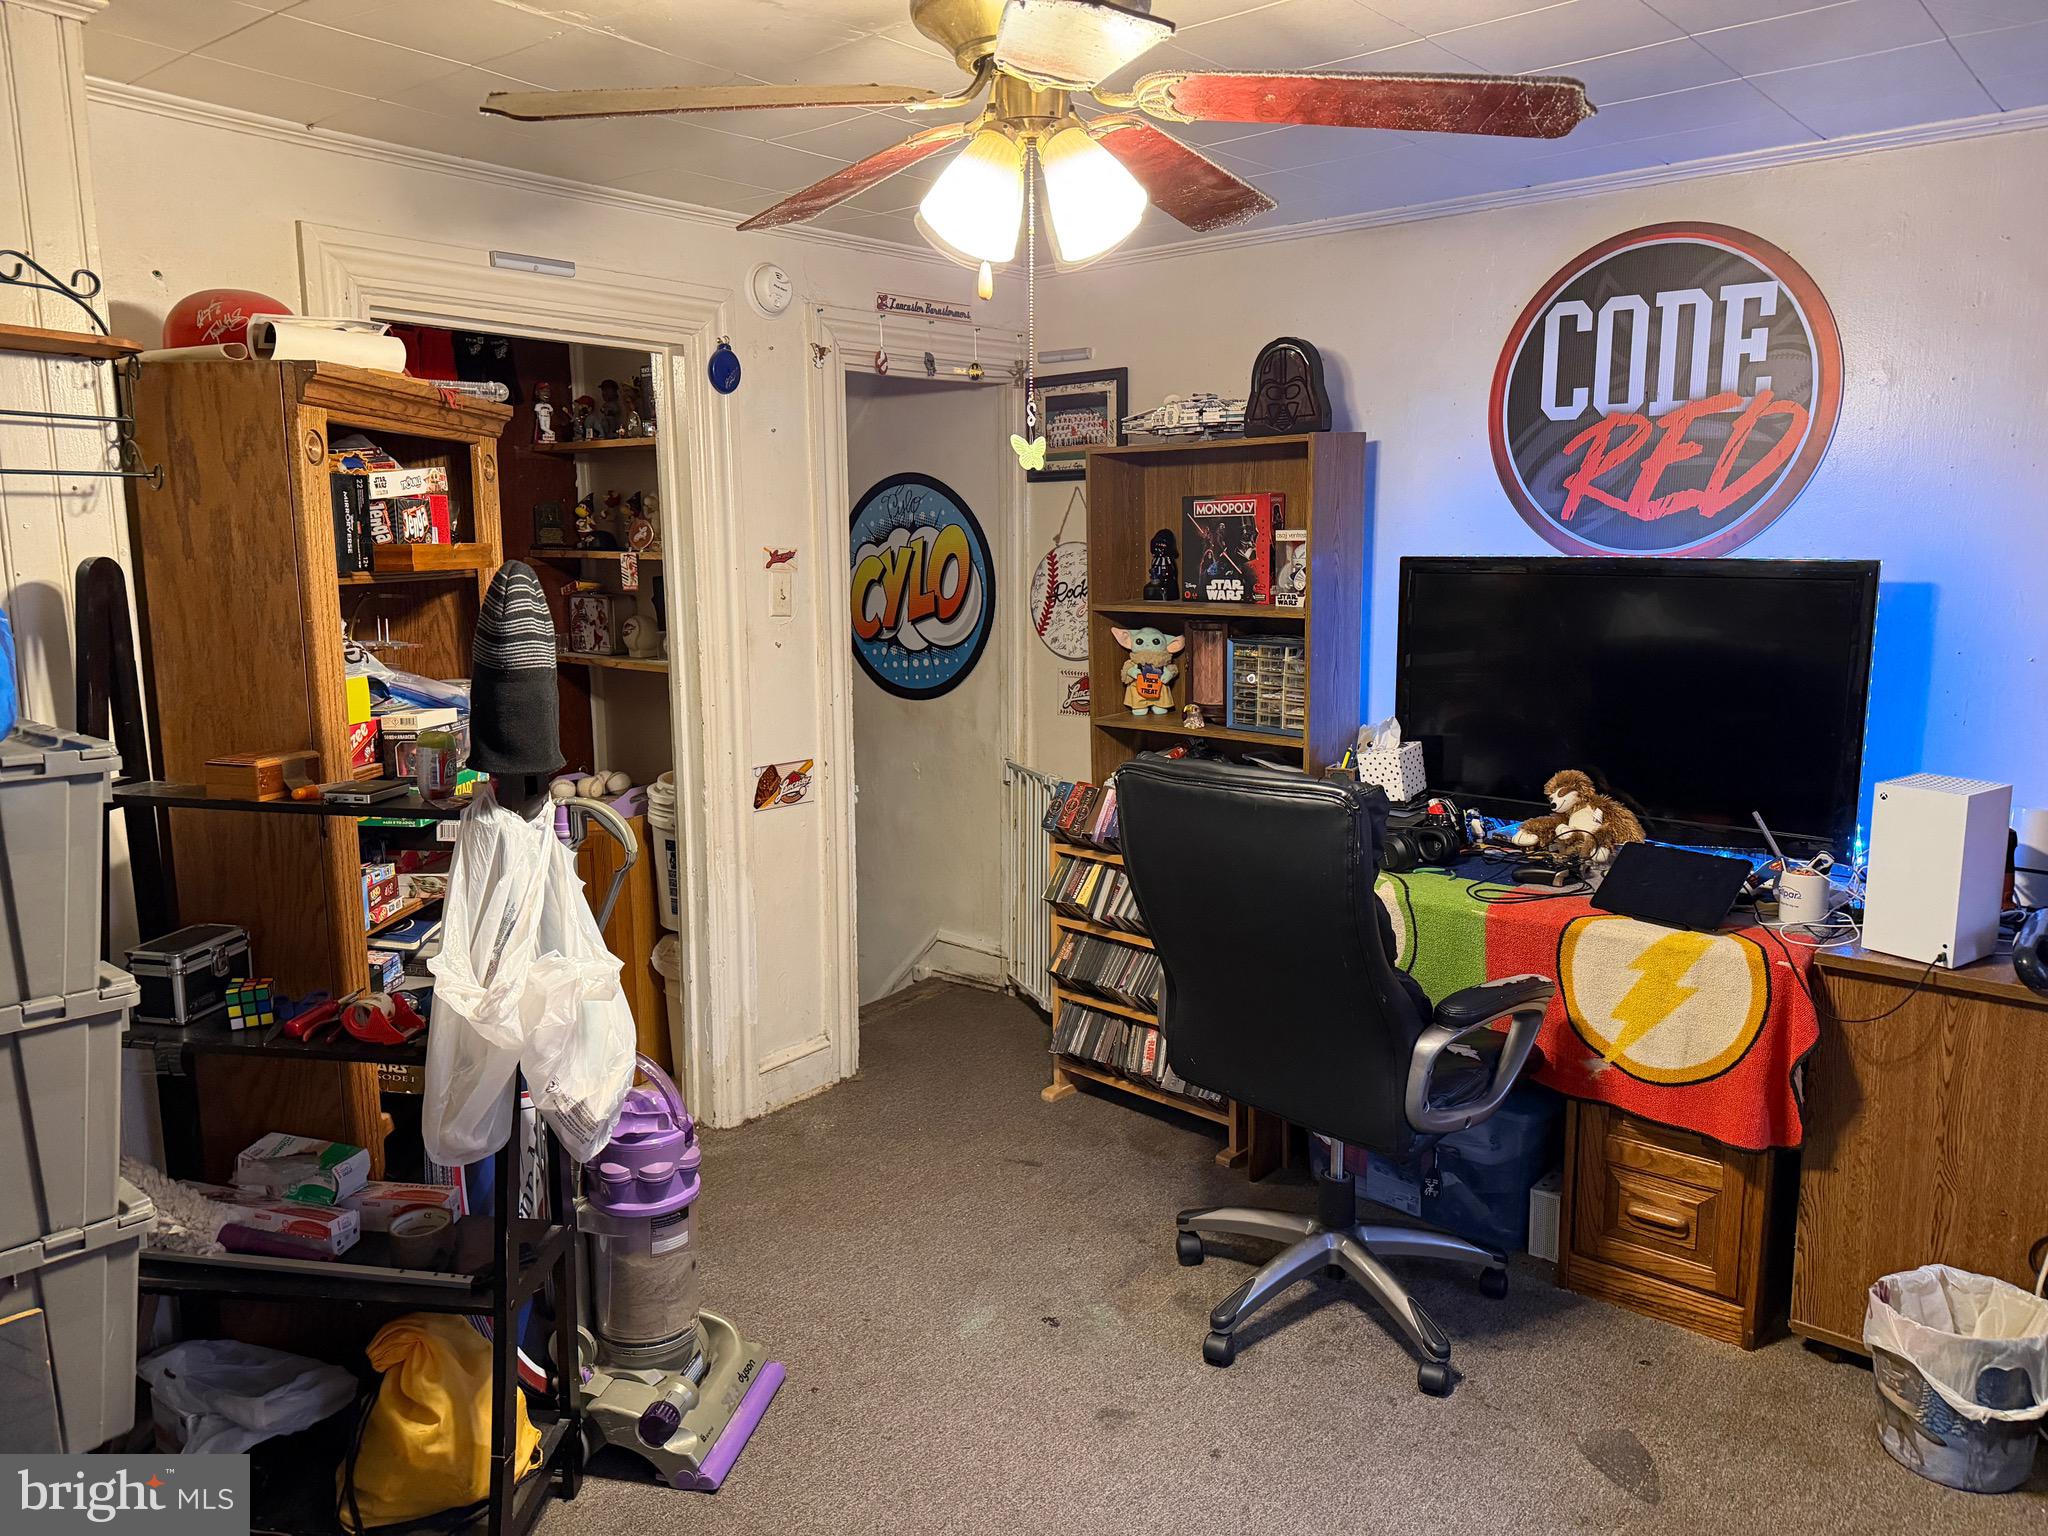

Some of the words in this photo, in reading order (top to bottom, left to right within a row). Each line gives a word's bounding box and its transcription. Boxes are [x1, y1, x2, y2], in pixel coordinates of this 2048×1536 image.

[889, 297, 924, 313] Lancaster
[925, 302, 971, 319] Barnstormers
[1540, 280, 1779, 421] CODE
[1561, 390, 1810, 521] RED
[356, 479, 363, 489] 22
[881, 483, 928, 517] Cylo
[1196, 502, 1254, 515] MONOPOLY
[343, 490, 354, 555] MIRRORVERSE
[369, 501, 392, 544] Jenga
[402, 504, 430, 540] Jenga
[851, 523, 971, 641] CYLO
[1205, 579, 1244, 590] STAR
[1206, 590, 1244, 601] WARS
[351, 723, 369, 750] zee
[377, 1063, 409, 1075] ARS
[737, 1359, 756, 1384] dyson
